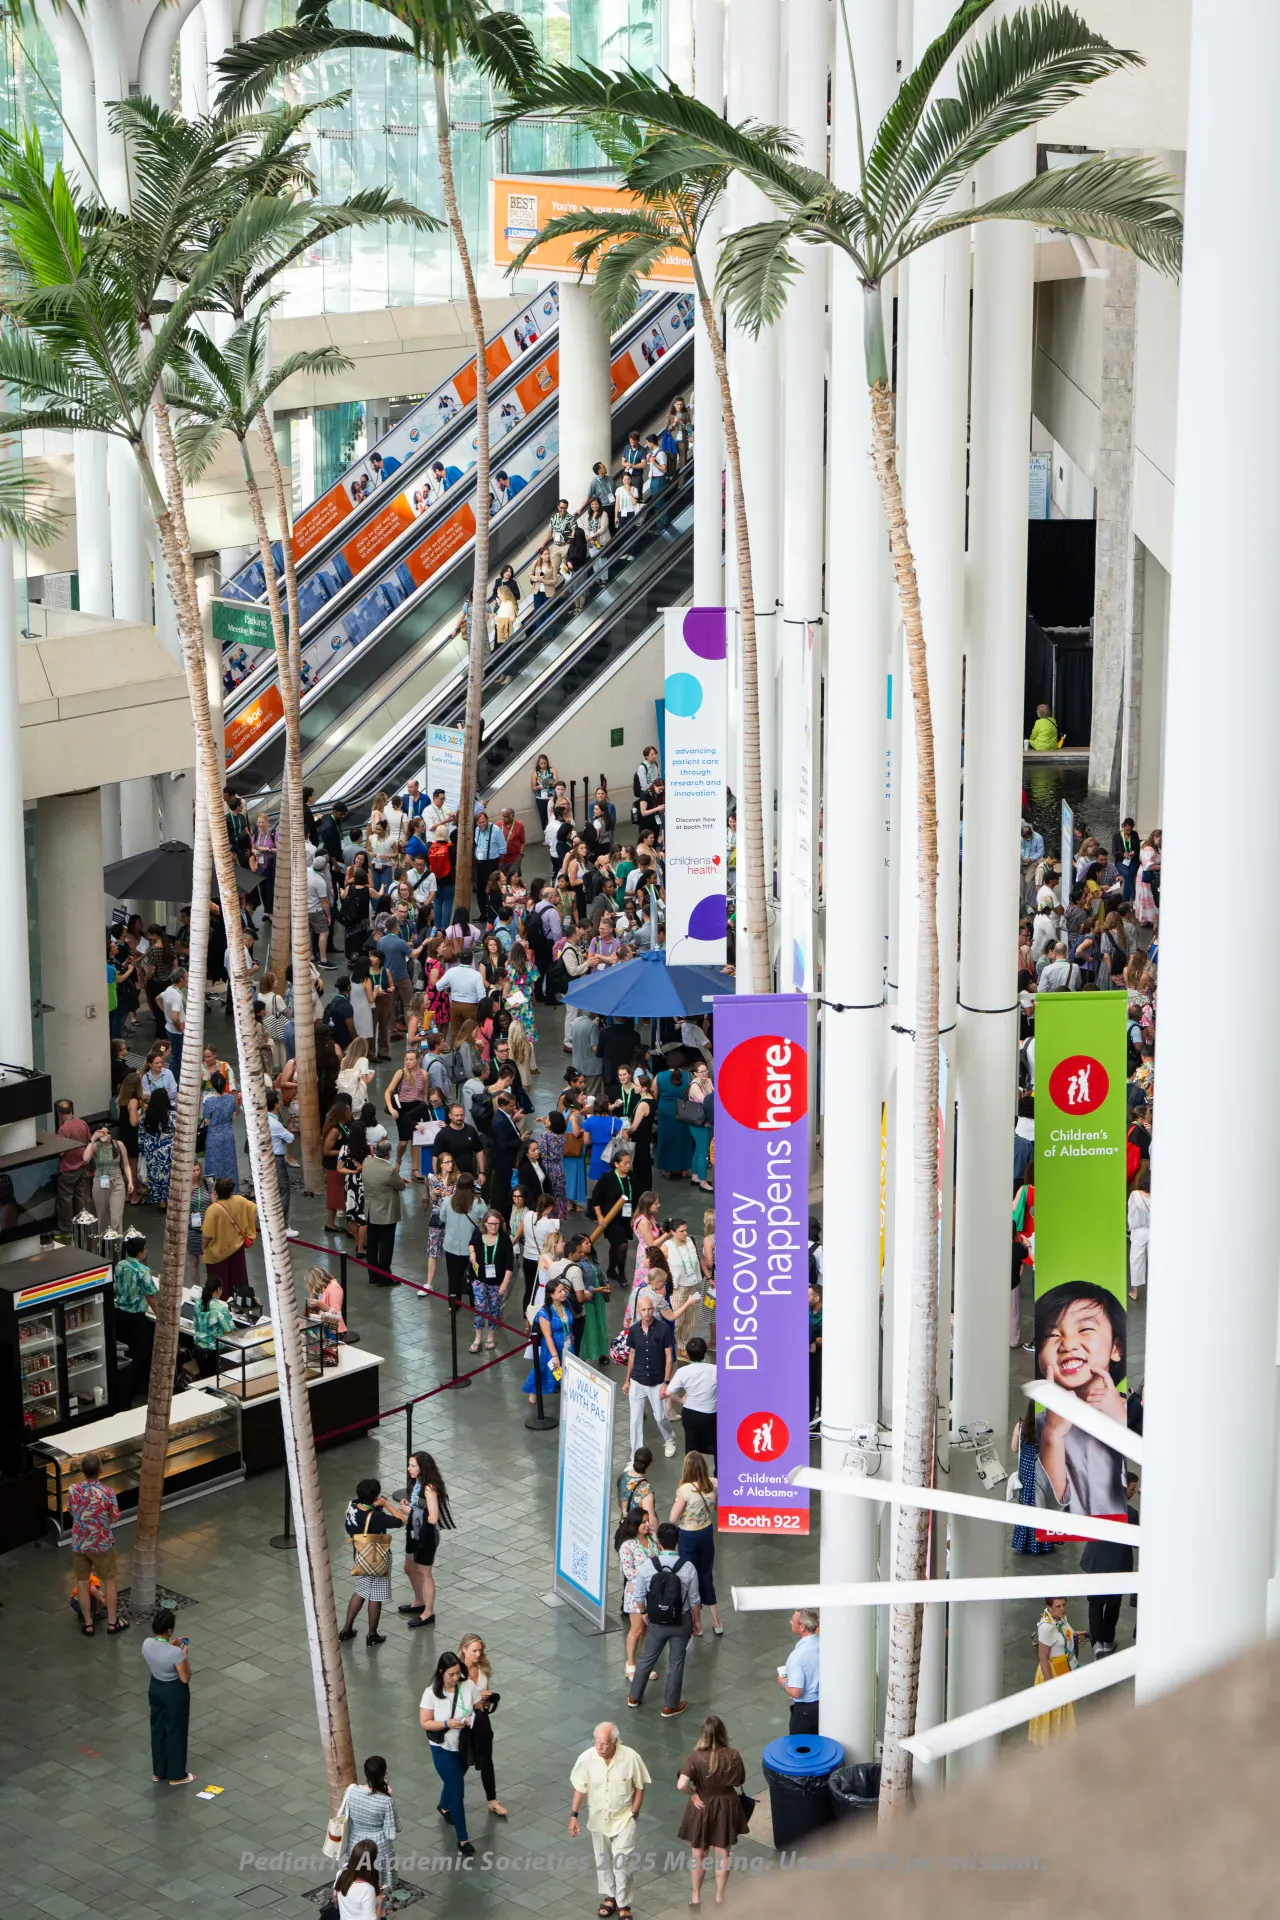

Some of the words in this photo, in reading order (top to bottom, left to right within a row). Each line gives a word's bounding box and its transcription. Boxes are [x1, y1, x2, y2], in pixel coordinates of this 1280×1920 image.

[510, 197, 535, 210] BEST
[552, 201, 577, 212] You're
[244, 615, 267, 630] Parking
[228, 624, 250, 636] Meeting
[250, 628, 267, 638] Rooms
[246, 708, 263, 725] 906
[234, 733, 250, 750] Seattle
[250, 710, 272, 734] Children's
[434, 734, 446, 742] PAS
[448, 736, 463, 745] 2025
[669, 856, 711, 866] children's
[687, 866, 717, 875] health
[758, 1038, 792, 1129] here.
[1050, 1129, 1108, 1141] Children's
[1044, 1145, 1056, 1157] of
[760, 1140, 800, 1296] happens
[725, 1192, 765, 1371] Discovery
[578, 1378, 598, 1403] WALK
[570, 1387, 588, 1411] WITH
[591, 1403, 605, 1422] PAS
[738, 1473, 788, 1484] Children's
[733, 1486, 744, 1496] of
[728, 1514, 770, 1527] Booth
[774, 1515, 800, 1528] 922
